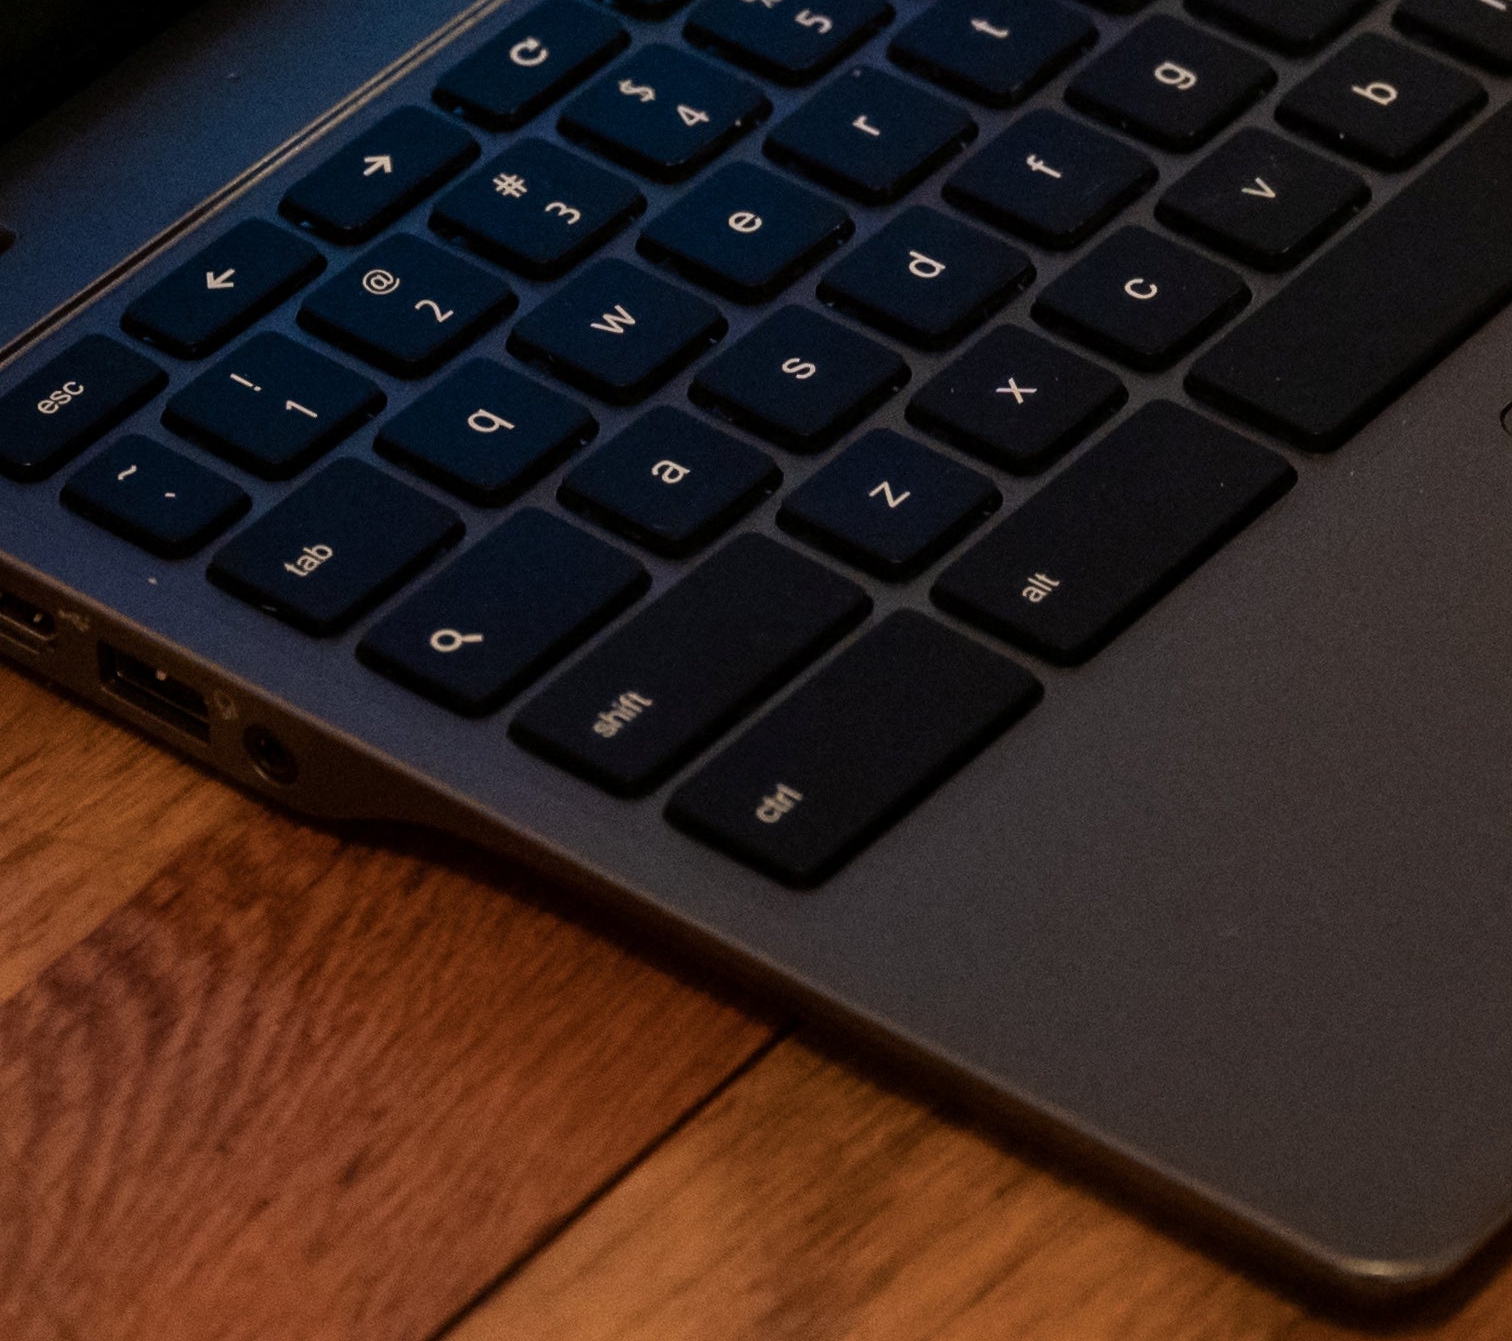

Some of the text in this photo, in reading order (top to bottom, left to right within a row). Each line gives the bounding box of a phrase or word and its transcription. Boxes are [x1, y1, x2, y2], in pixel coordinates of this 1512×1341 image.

[795, 9, 833, 34] 5
[971, 19, 1009, 39] t
[1153, 61, 1198, 91] g
[619, 79, 656, 103] $
[1351, 81, 1398, 106] b
[676, 104, 710, 127] 4
[852, 115, 880, 137] r
[1026, 154, 1062, 179] f
[492, 173, 528, 198] #
[1241, 177, 1277, 199] v
[544, 201, 582, 225] 3
[727, 211, 763, 234] e
[908, 250, 946, 279] d
[361, 268, 401, 296] @
[1123, 277, 1158, 300] c
[414, 299, 454, 323] 2
[781, 357, 817, 380] s
[229, 373, 262, 392] !
[995, 377, 1037, 405] x
[36, 380, 85, 415] esc
[285, 399, 318, 419] 1
[467, 408, 515, 433] q
[651, 459, 690, 485] a
[868, 480, 911, 509] z
[283, 544, 334, 577] tab
[1021, 572, 1060, 603] alt
[592, 691, 653, 738] shift
[755, 783, 802, 824] ctrl
